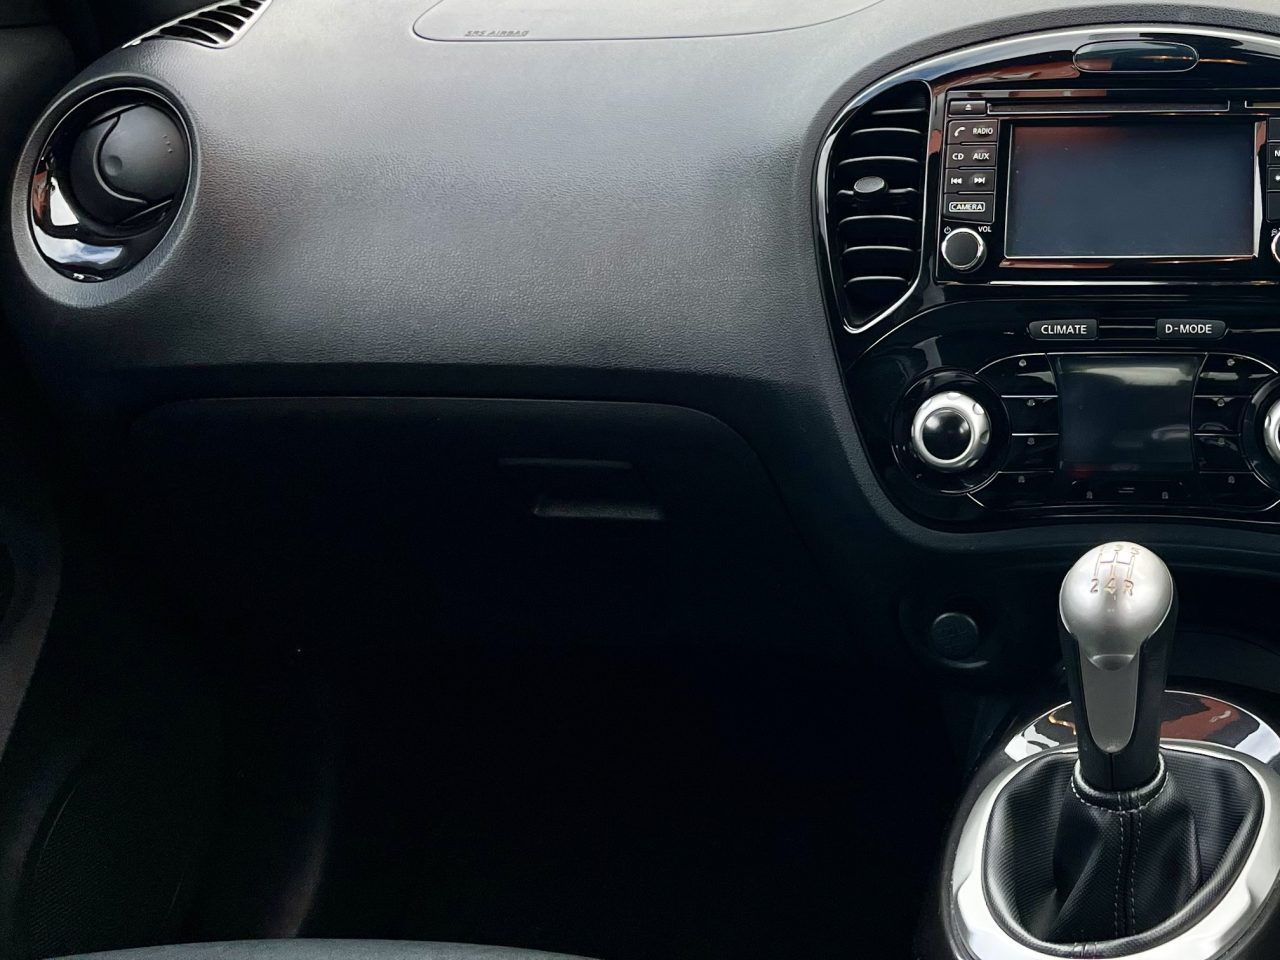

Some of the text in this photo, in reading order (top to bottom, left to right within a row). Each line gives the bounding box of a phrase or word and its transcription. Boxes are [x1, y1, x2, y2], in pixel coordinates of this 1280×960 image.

[464, 29, 530, 38] SRS AIRBAG
[972, 127, 994, 135] RADIO
[952, 152, 990, 160] CD AUX
[1040, 324, 1088, 335] CLIMATE
[1165, 324, 1213, 334] D-MODE
[1090, 578, 1099, 593] 2
